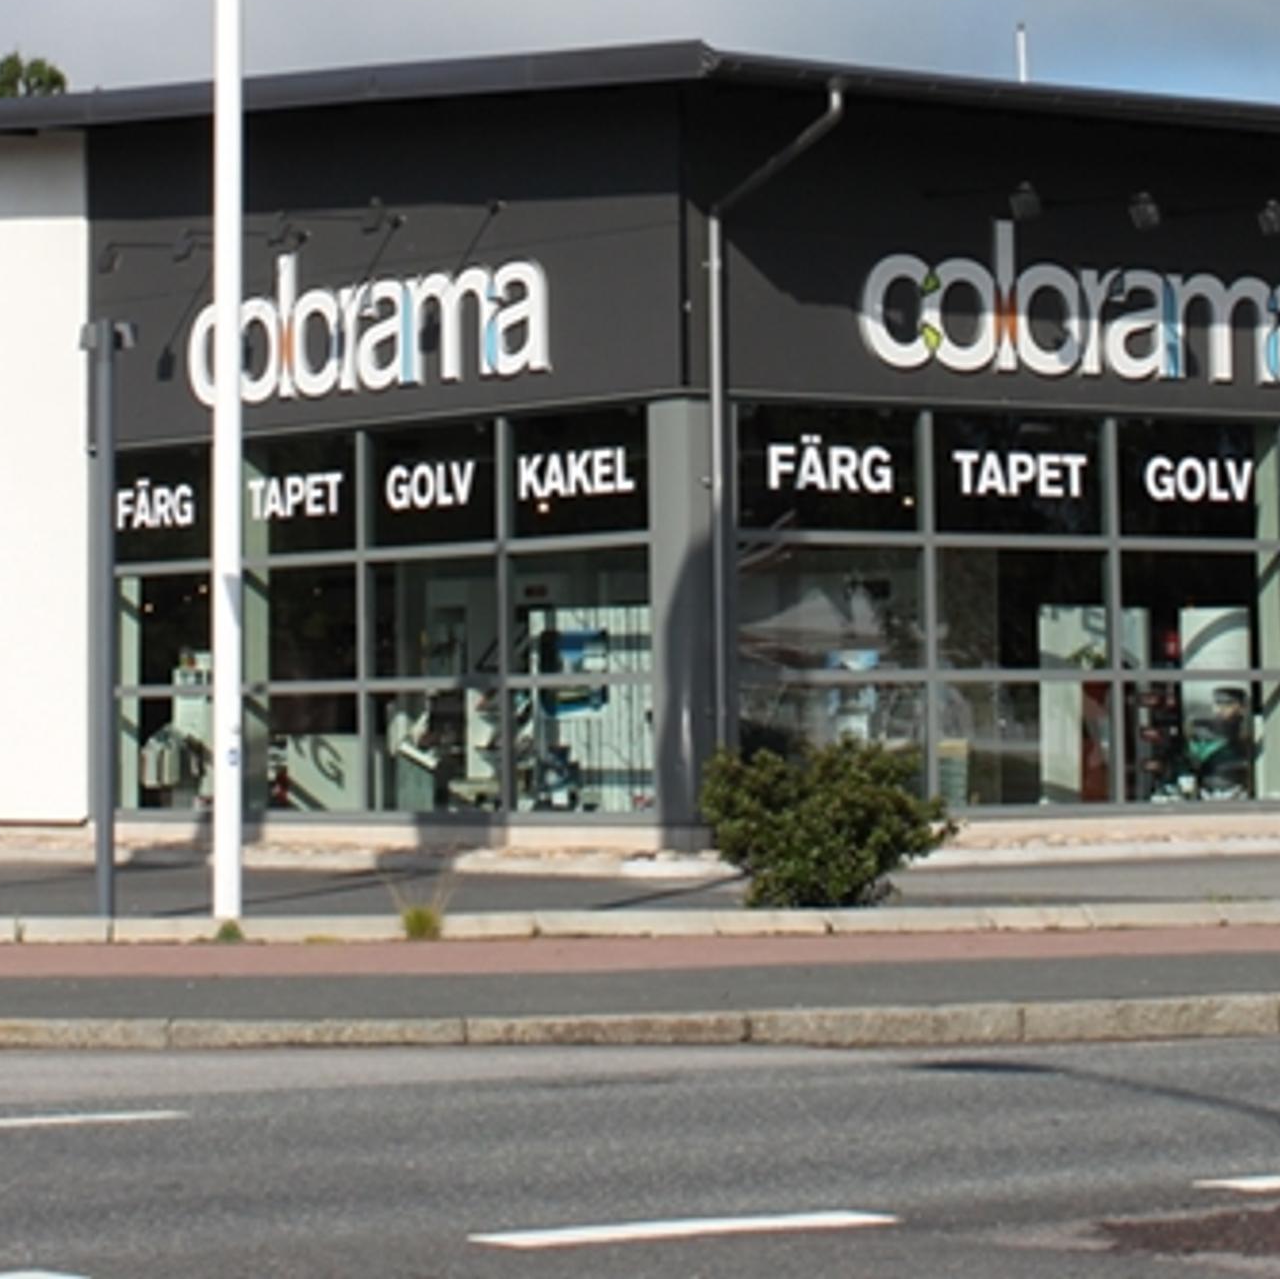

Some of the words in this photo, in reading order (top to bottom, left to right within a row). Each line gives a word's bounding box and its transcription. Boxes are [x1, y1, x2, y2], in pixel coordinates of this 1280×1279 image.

[386, 460, 475, 509] GOLV
[518, 446, 635, 497] KAKEL
[767, 435, 893, 494] FÄRG
[953, 450, 1088, 498] TAPET
[1145, 456, 1254, 502] GOLV
[116, 478, 195, 530] FÄRG
[247, 472, 343, 521] TAPET
